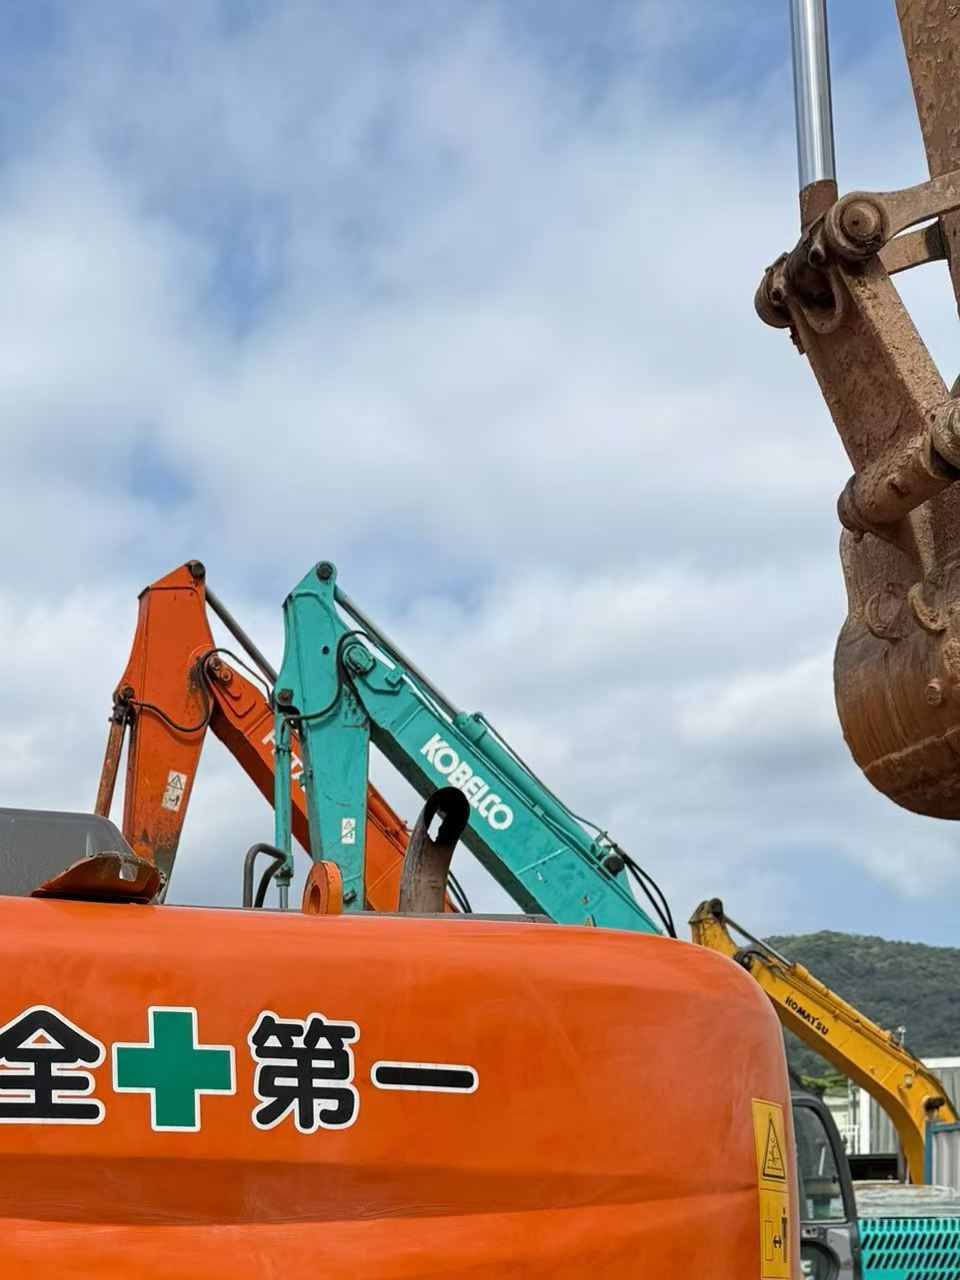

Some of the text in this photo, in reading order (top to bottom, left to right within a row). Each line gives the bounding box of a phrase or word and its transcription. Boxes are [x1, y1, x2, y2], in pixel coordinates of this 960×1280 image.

[420, 733, 513, 830] KOBELCO
[785, 996, 829, 1035] KOMATSU
[251, 1011, 479, 1134] 第一
